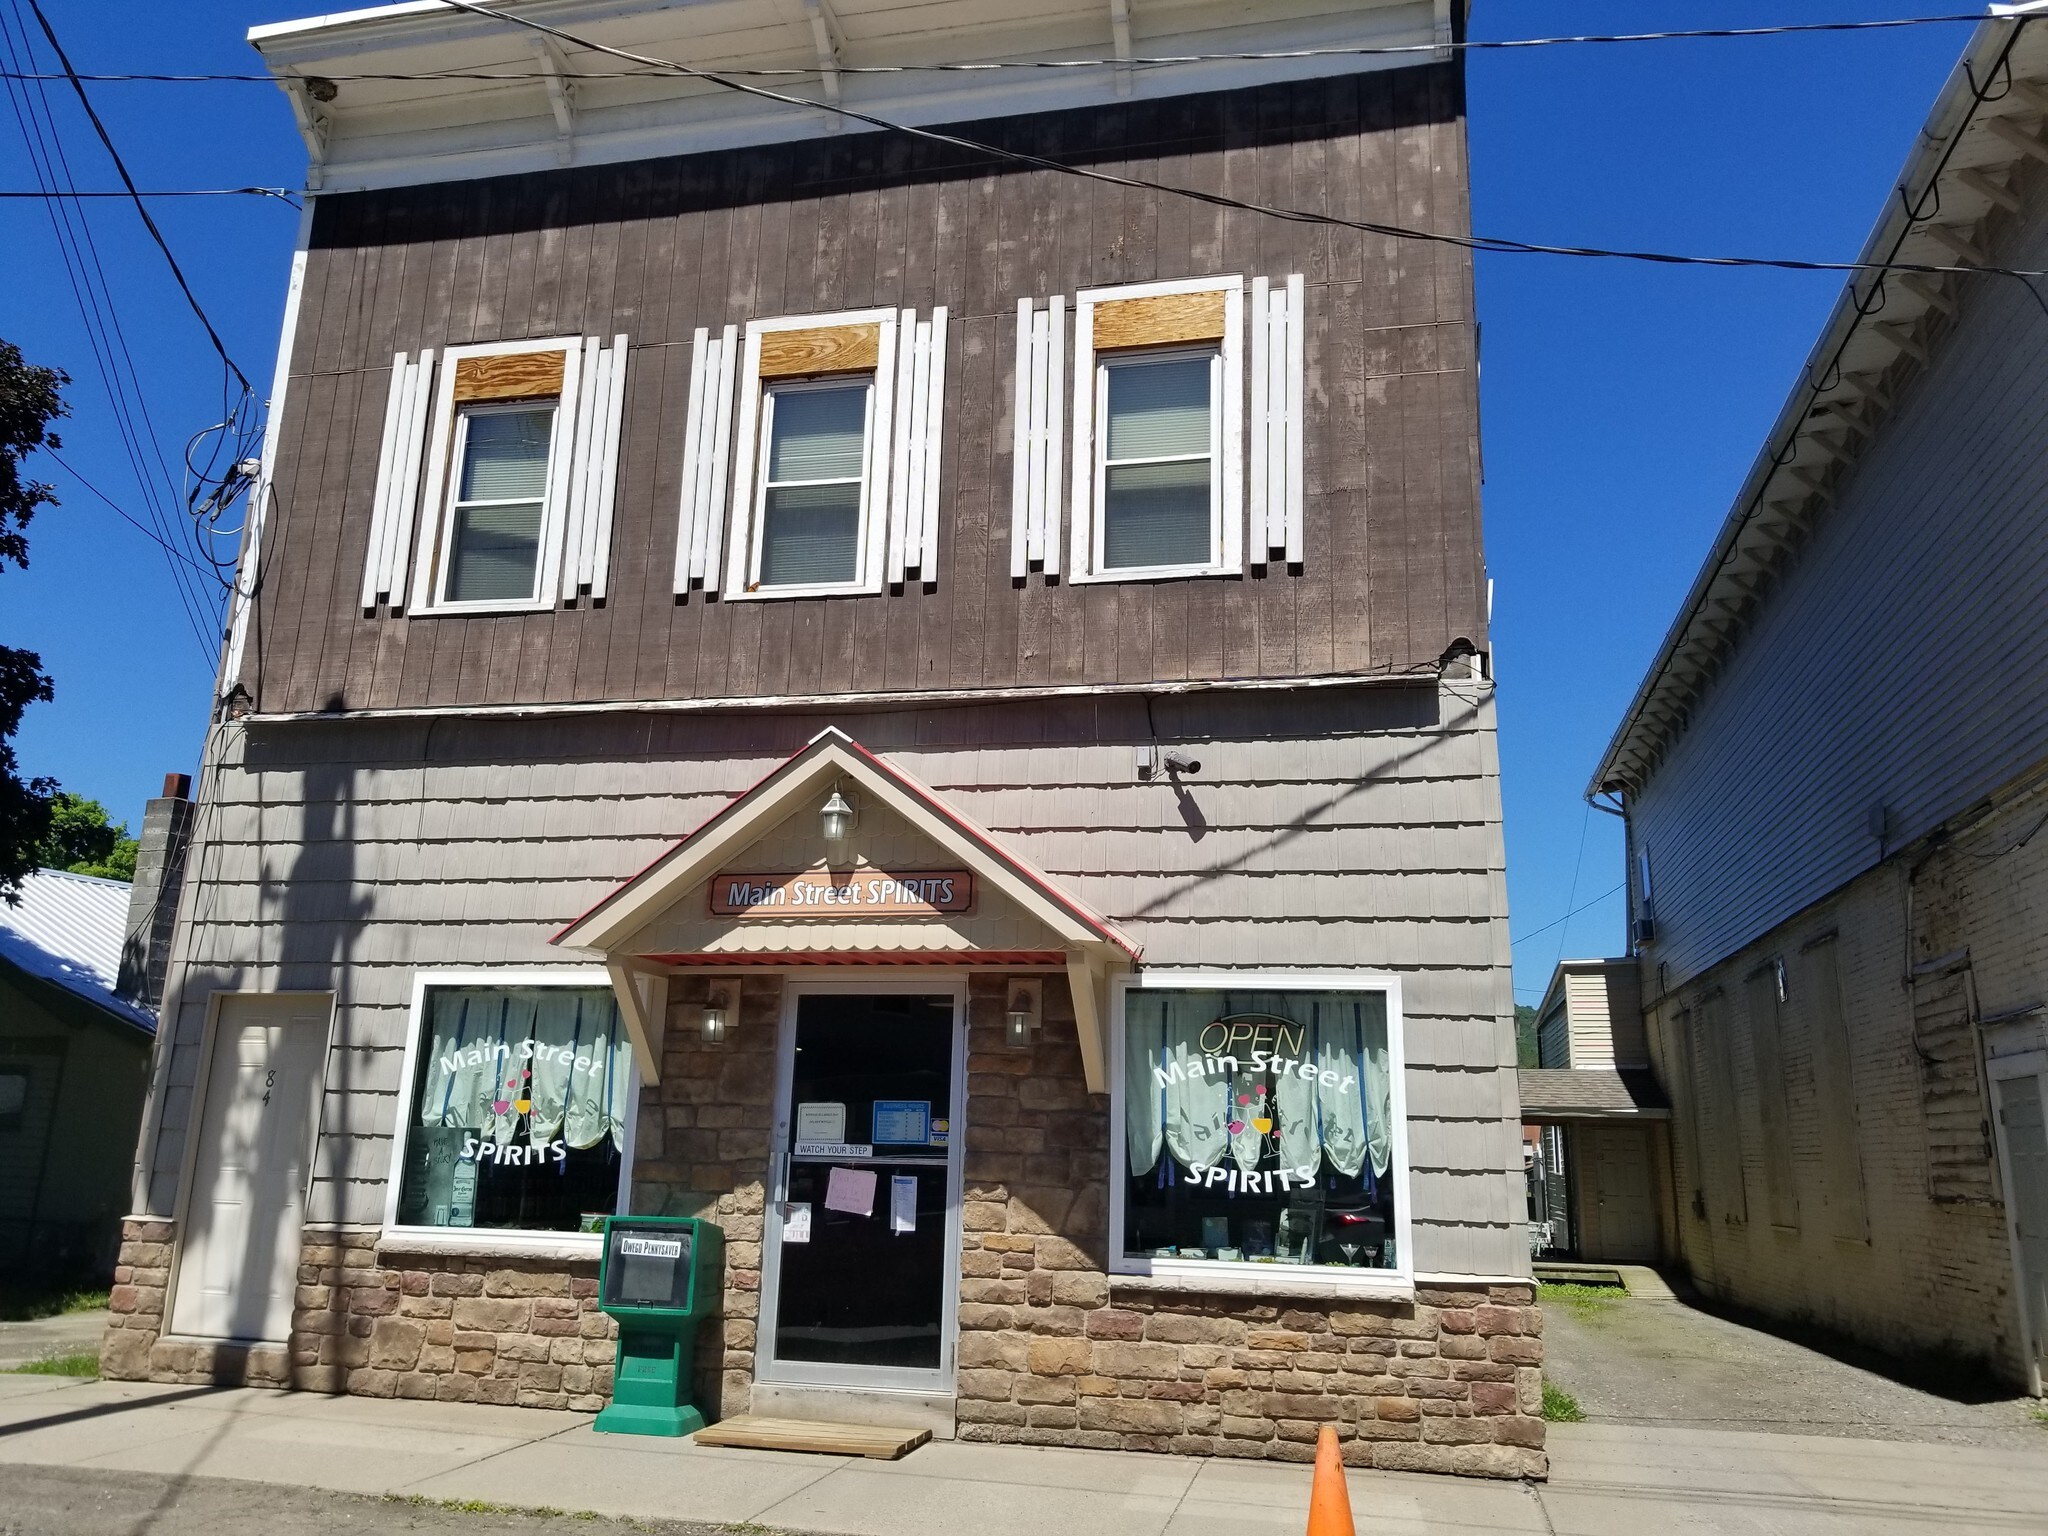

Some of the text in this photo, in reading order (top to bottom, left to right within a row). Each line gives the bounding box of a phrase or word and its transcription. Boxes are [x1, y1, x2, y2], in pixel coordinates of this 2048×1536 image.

[728, 878, 954, 906] Main Street SPIRITS
[1199, 1022, 1306, 1057] OPEN
[440, 1039, 603, 1077] Main Street
[1153, 1051, 1356, 1094] Main Street
[460, 1138, 566, 1166] SPIRITS
[800, 1145, 868, 1155] WATCH YOUR STEP
[1184, 1163, 1317, 1194] SPIRITS
